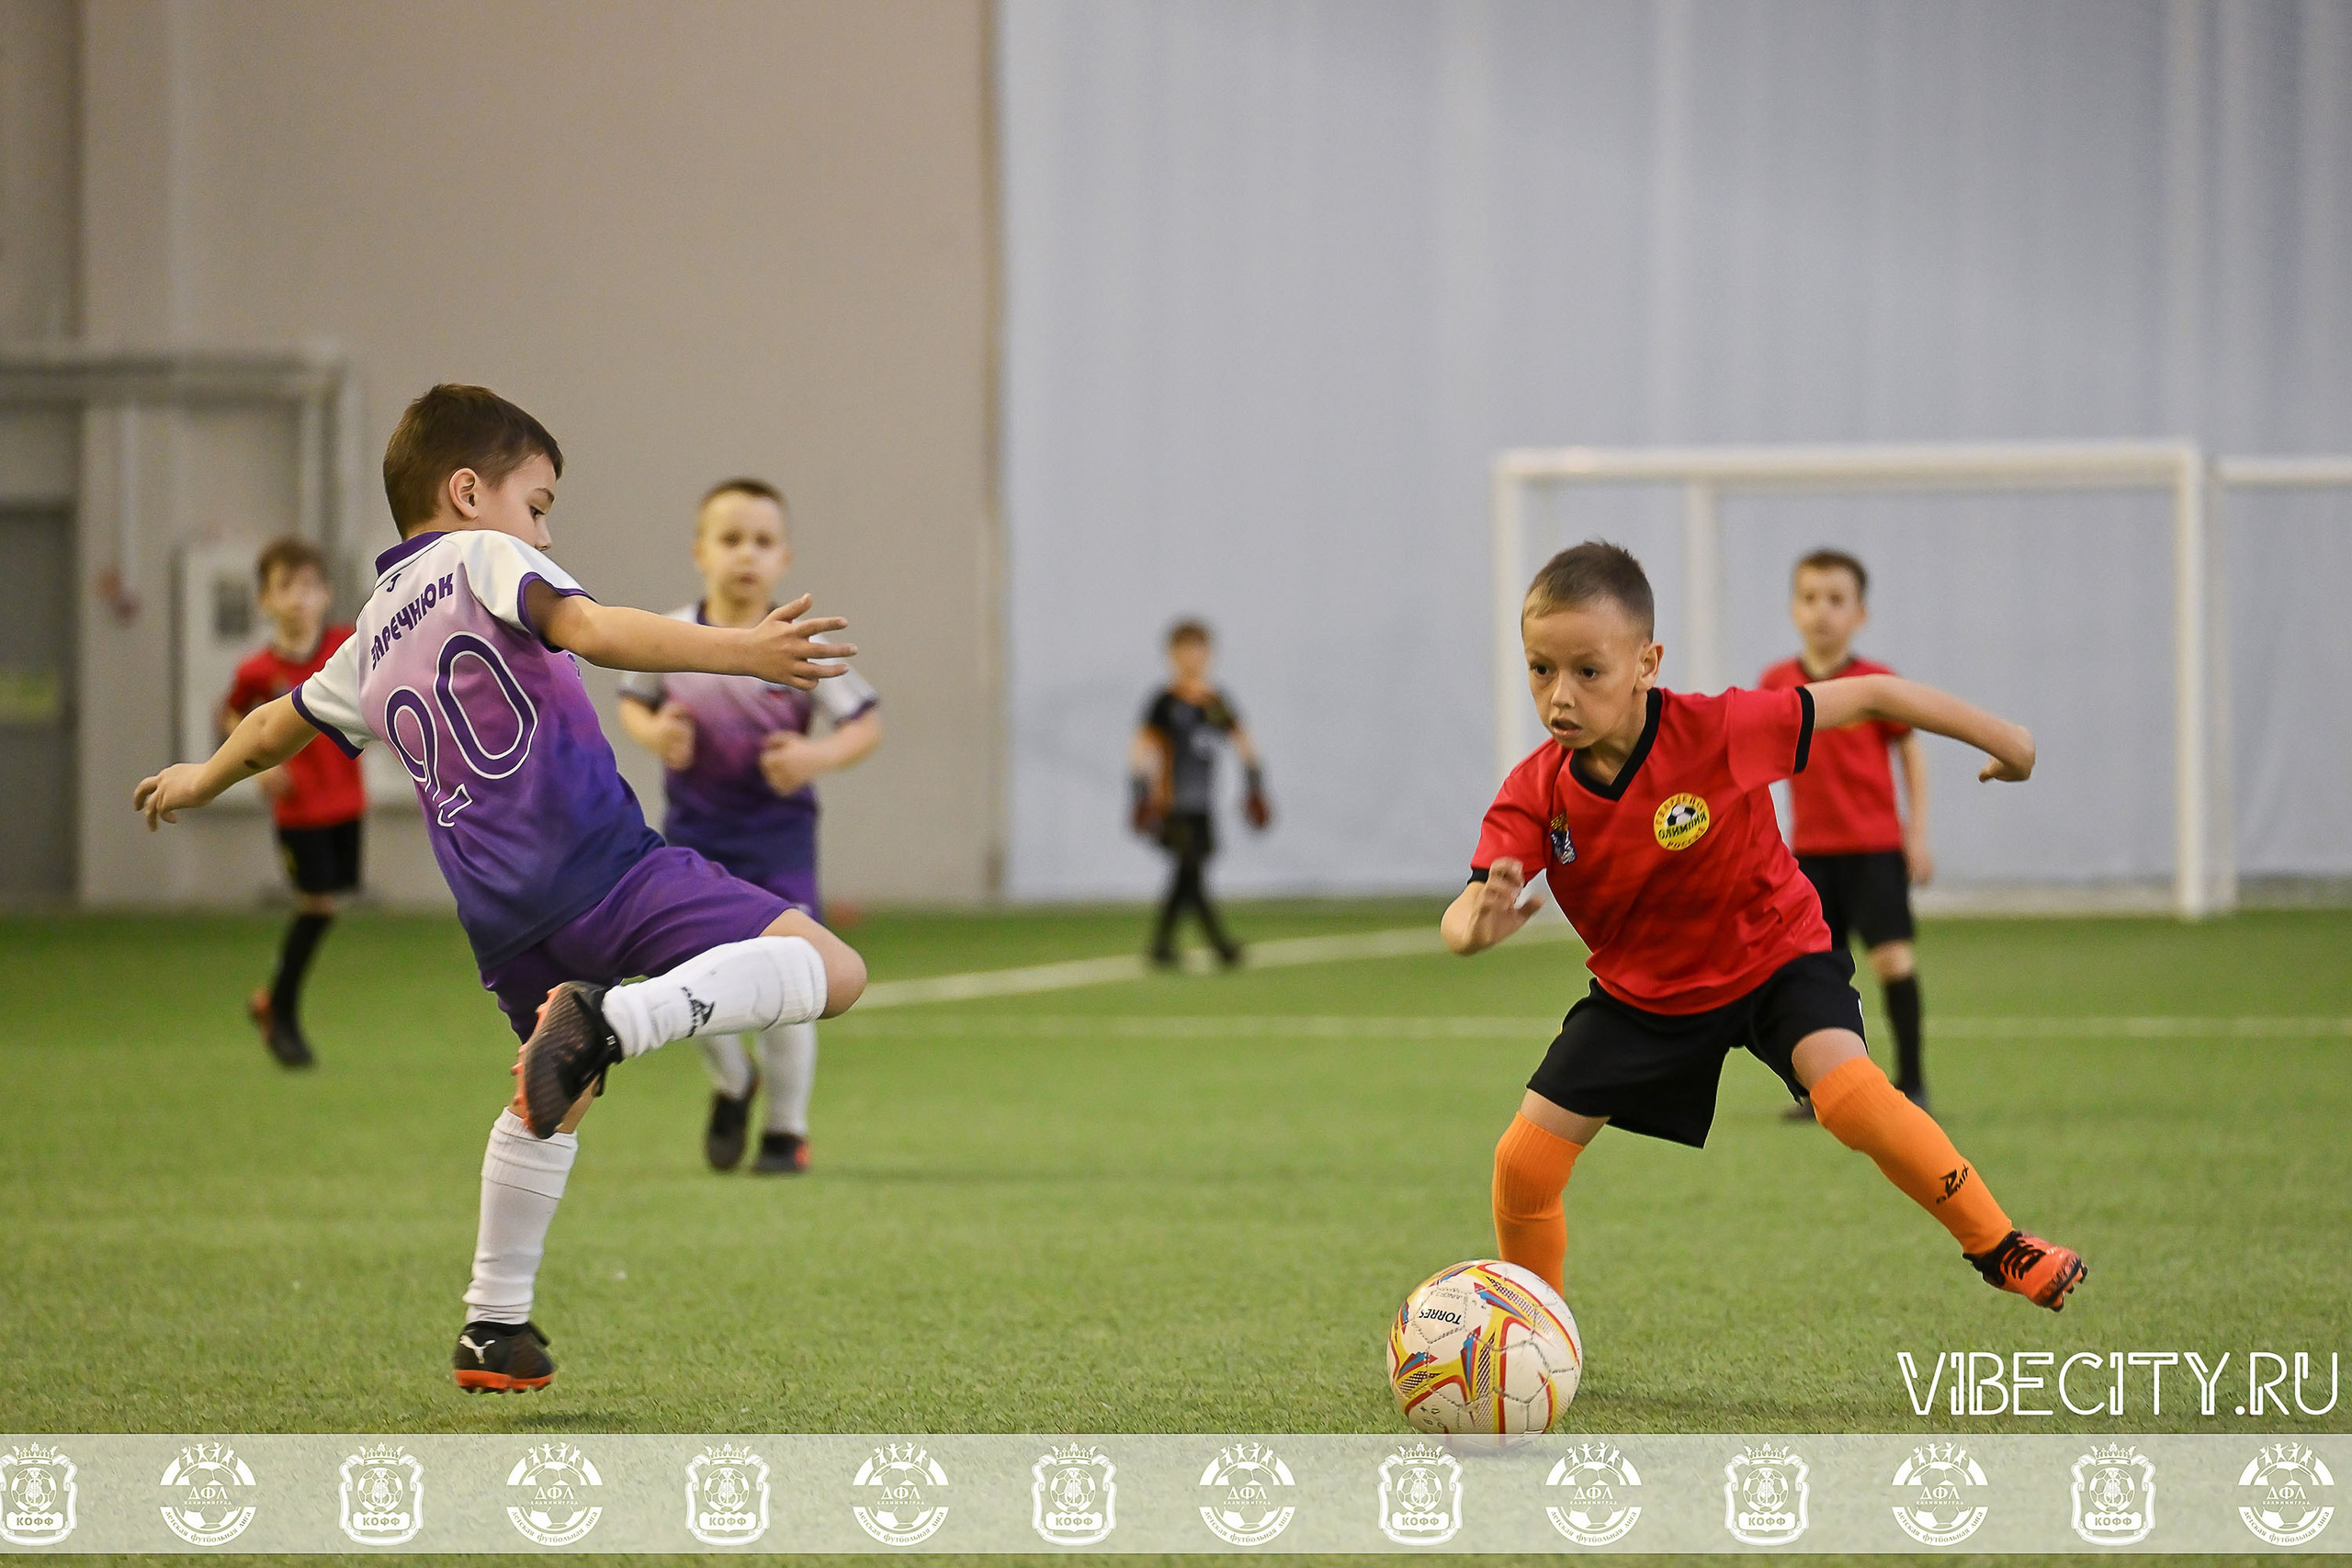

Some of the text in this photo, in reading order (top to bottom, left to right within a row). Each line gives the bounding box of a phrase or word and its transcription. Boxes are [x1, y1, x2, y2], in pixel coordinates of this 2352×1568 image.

[371, 572, 454, 671] ЗАРЕЧНЮК
[384, 630, 538, 828] 90
[1419, 1308, 1462, 1325] TORRES
